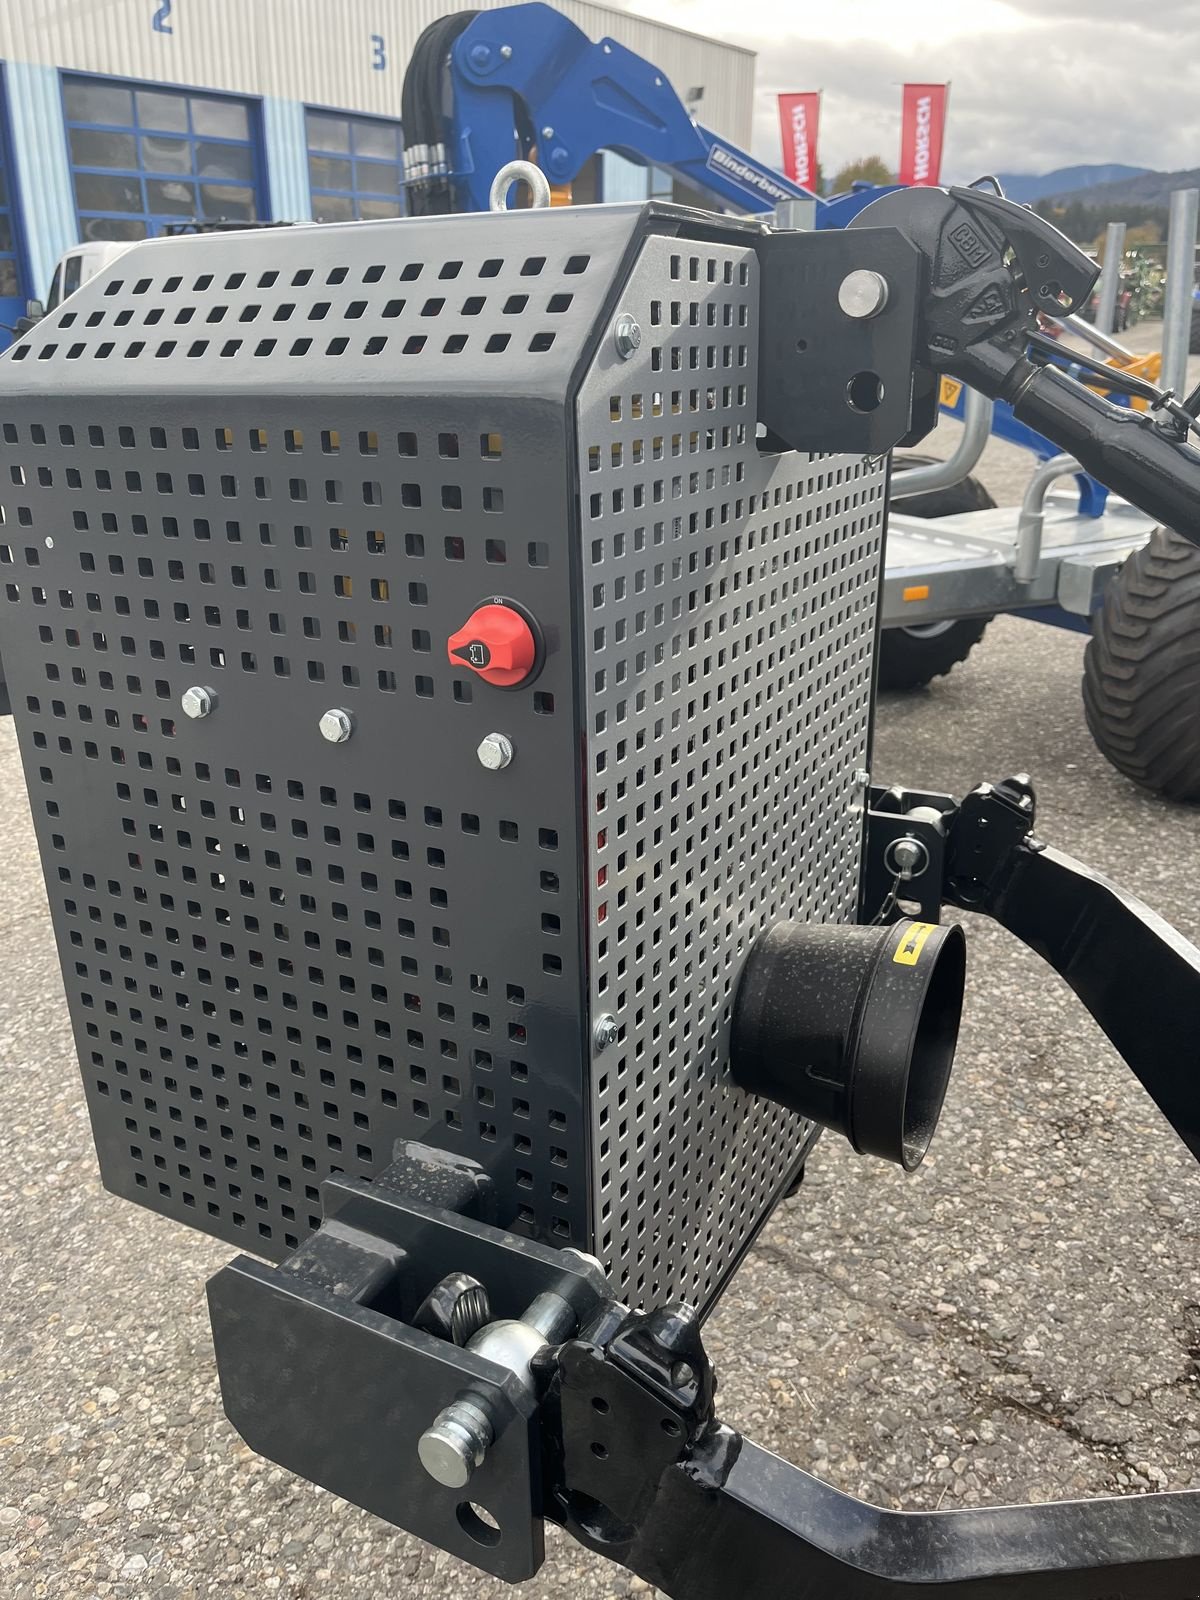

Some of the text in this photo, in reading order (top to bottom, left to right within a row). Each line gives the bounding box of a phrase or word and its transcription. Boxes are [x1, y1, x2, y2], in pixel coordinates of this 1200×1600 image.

[152, 0, 173, 34] 2
[370, 35, 386, 70] 3
[953, 228, 986, 264] CBM
